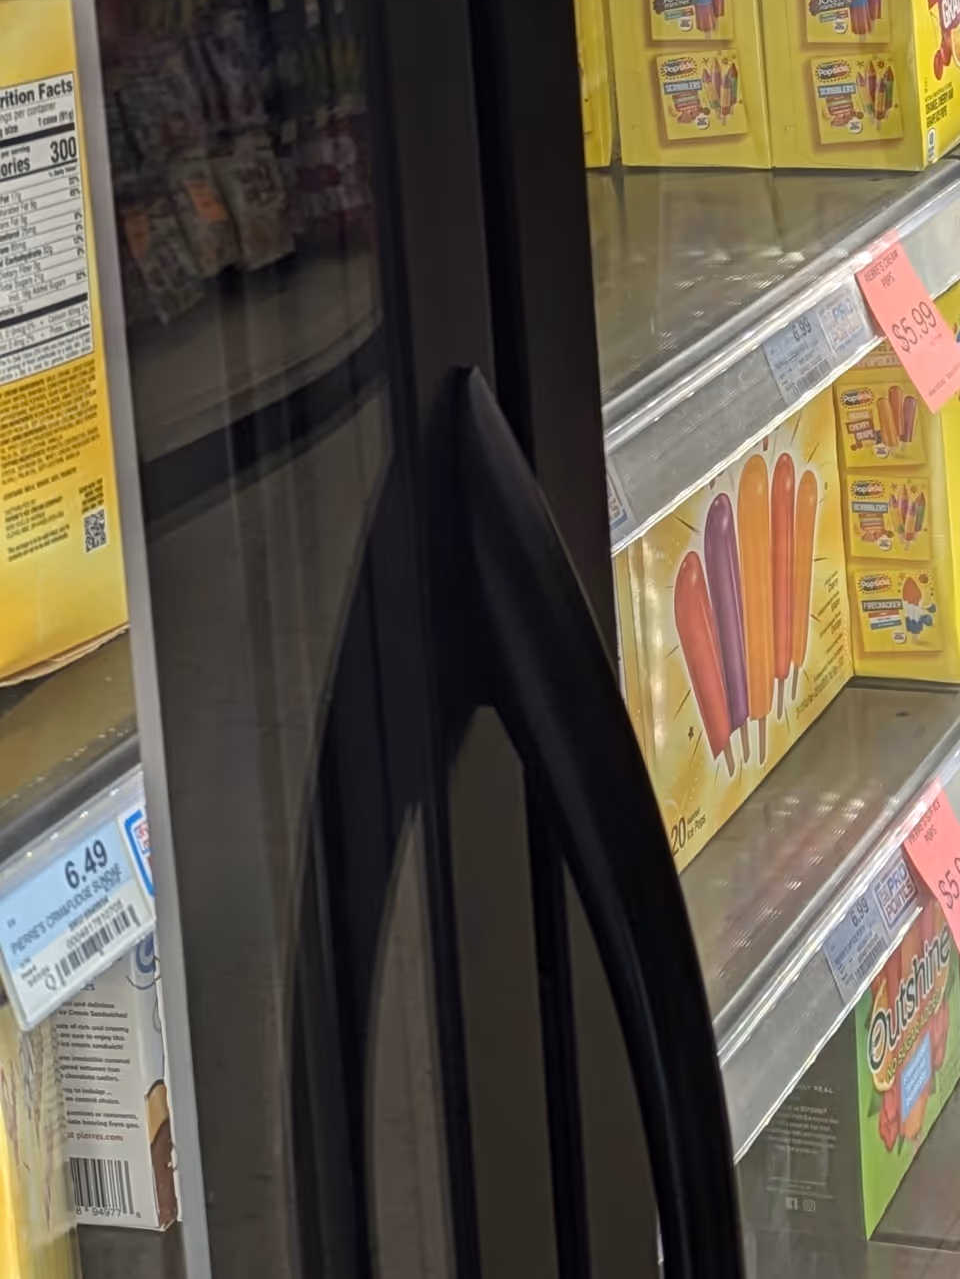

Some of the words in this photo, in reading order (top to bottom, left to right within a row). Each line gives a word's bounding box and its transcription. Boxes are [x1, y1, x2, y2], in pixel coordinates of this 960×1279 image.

[663, 61, 694, 74] Popsicle
[818, 64, 850, 77] Popsicle
[38, 79, 73, 100] Facts
[27, 102, 56, 118] container
[5, 124, 19, 135] size
[49, 136, 77, 164] 300
[5, 249, 42, 265] Carbohydrate
[881, 272, 896, 290] POPS
[793, 316, 812, 343] 6.99
[891, 300, 938, 355] $5.99
[863, 599, 902, 611] FIRECRACKER
[694, 814, 707, 833] Pops
[924, 823, 938, 844] POPS
[671, 816, 686, 857] 20
[65, 839, 109, 889] 6.49
[887, 861, 907, 896] PRO
[886, 878, 917, 921] POINTS
[850, 896, 870, 929] 6.99
[867, 925, 950, 1072] Outshine
[68, 1009, 89, 1017] Cream
[886, 1060, 897, 1080] NO
[897, 1024, 921, 1064] SUGAR
